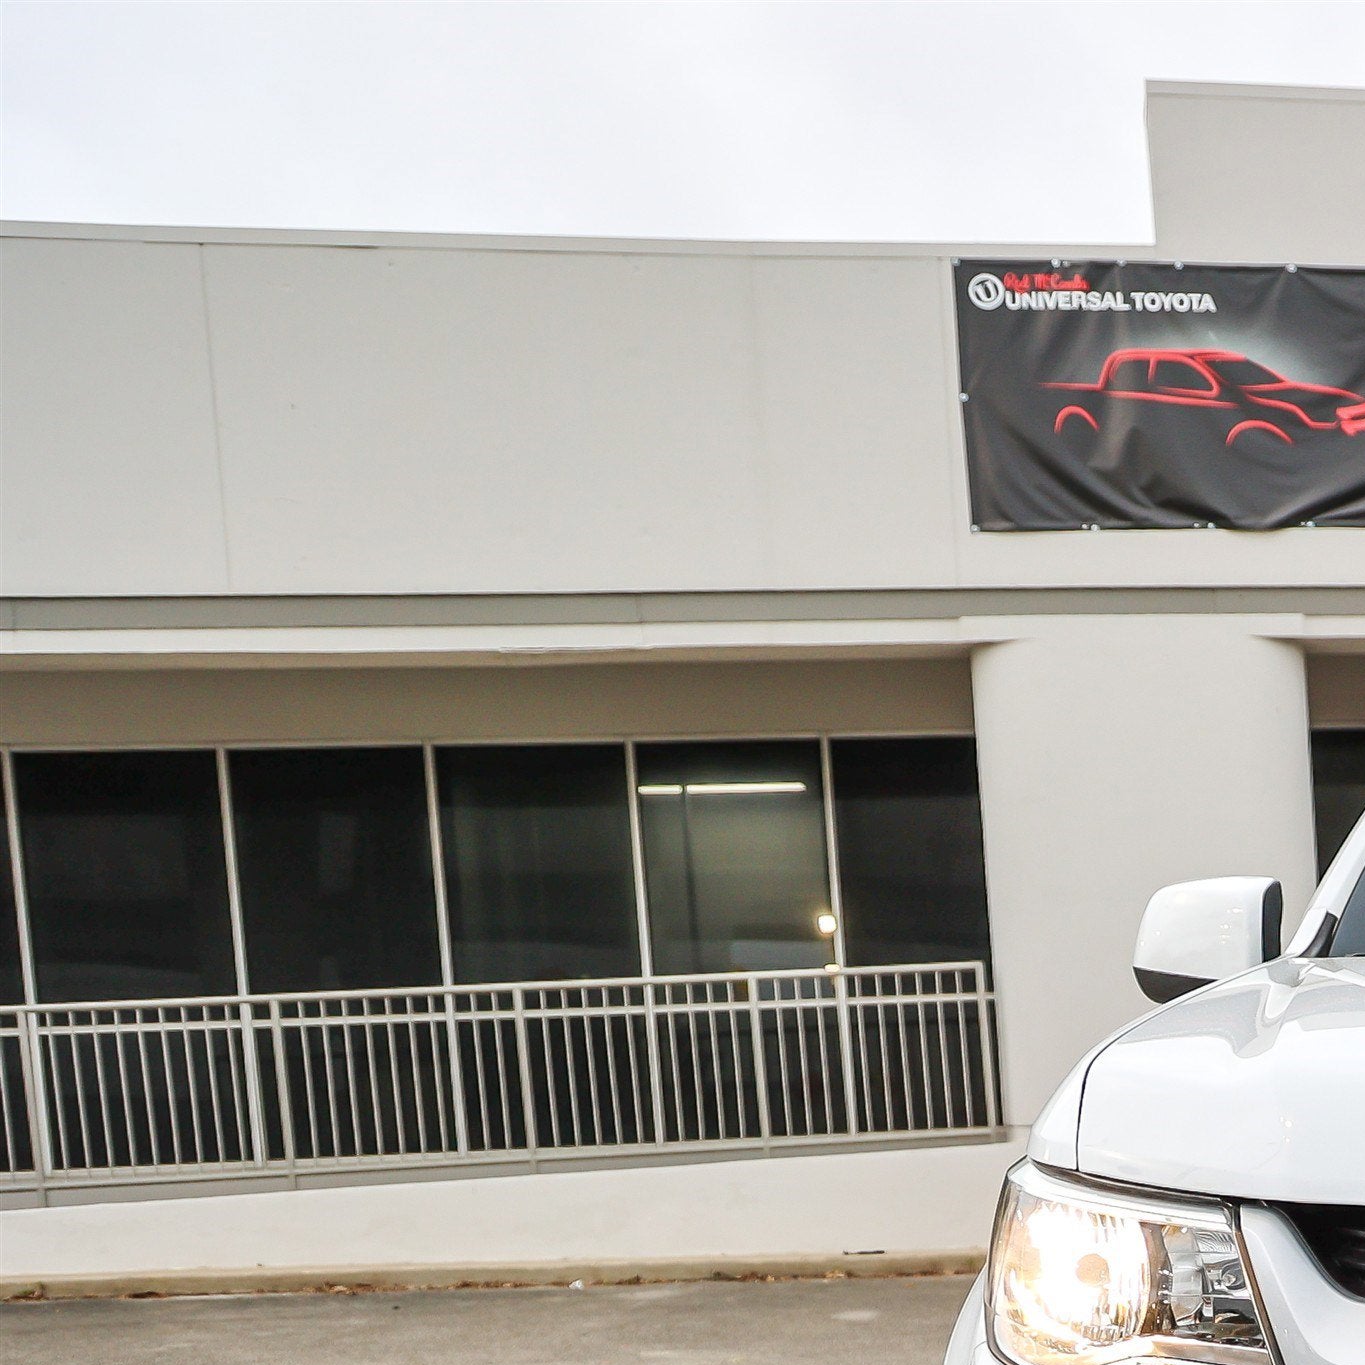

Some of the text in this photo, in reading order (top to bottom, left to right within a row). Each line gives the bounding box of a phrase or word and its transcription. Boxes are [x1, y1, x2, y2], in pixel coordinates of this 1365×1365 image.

[1003, 272, 1029, 293] Red
[1005, 290, 1217, 313] UNIVERSAL TOYOTA
